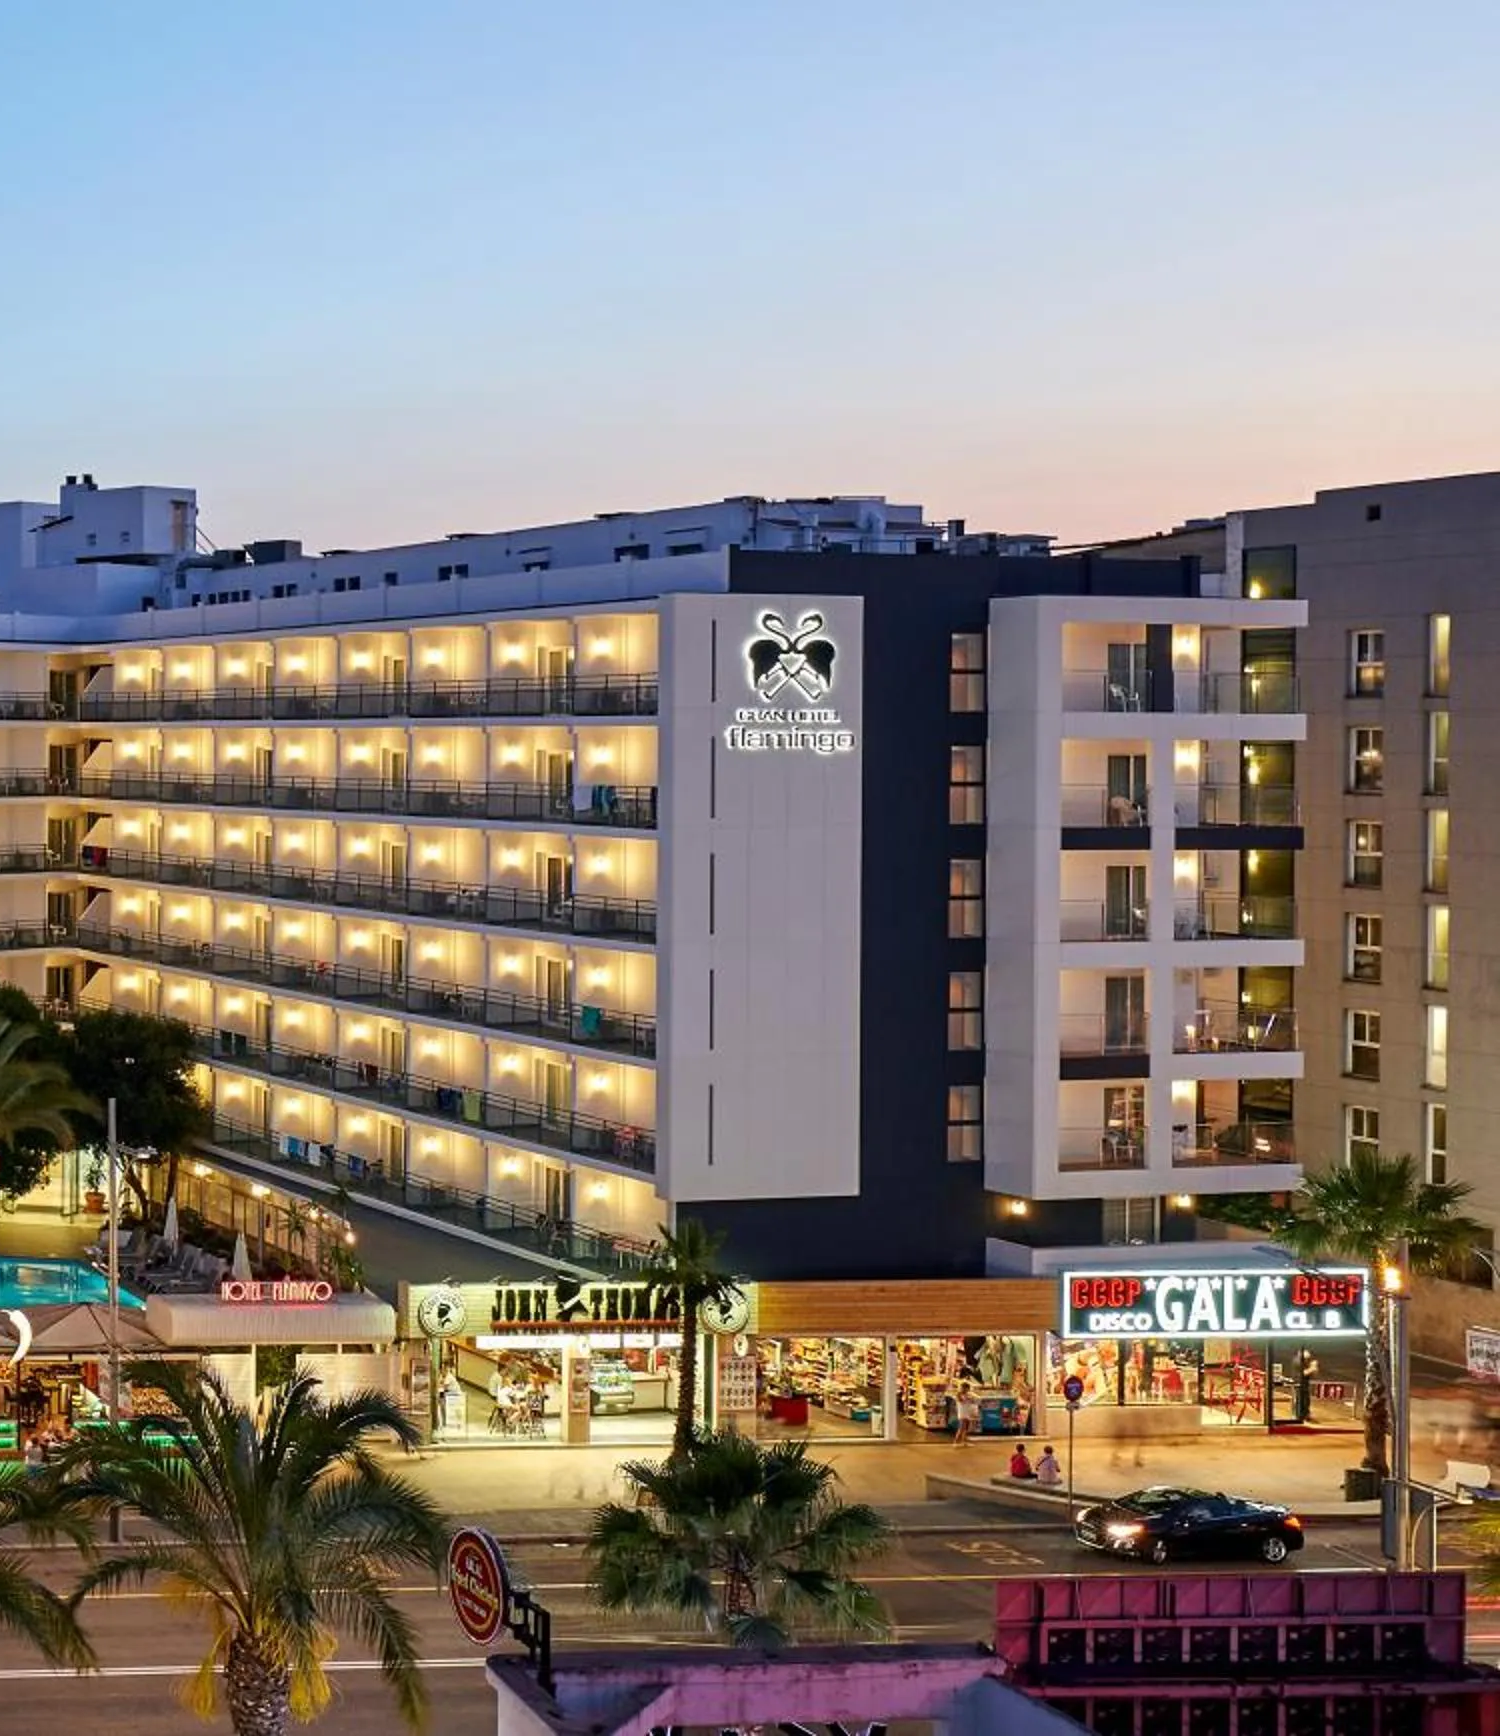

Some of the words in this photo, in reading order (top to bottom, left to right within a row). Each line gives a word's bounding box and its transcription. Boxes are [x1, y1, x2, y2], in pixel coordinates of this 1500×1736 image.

[725, 725, 855, 754] flamingo
[491, 1289, 548, 1321] JOHN
[1071, 1278, 1141, 1309] CCCP
[1088, 1312, 1153, 1331] DISCO
[1155, 1275, 1283, 1332] GALA
